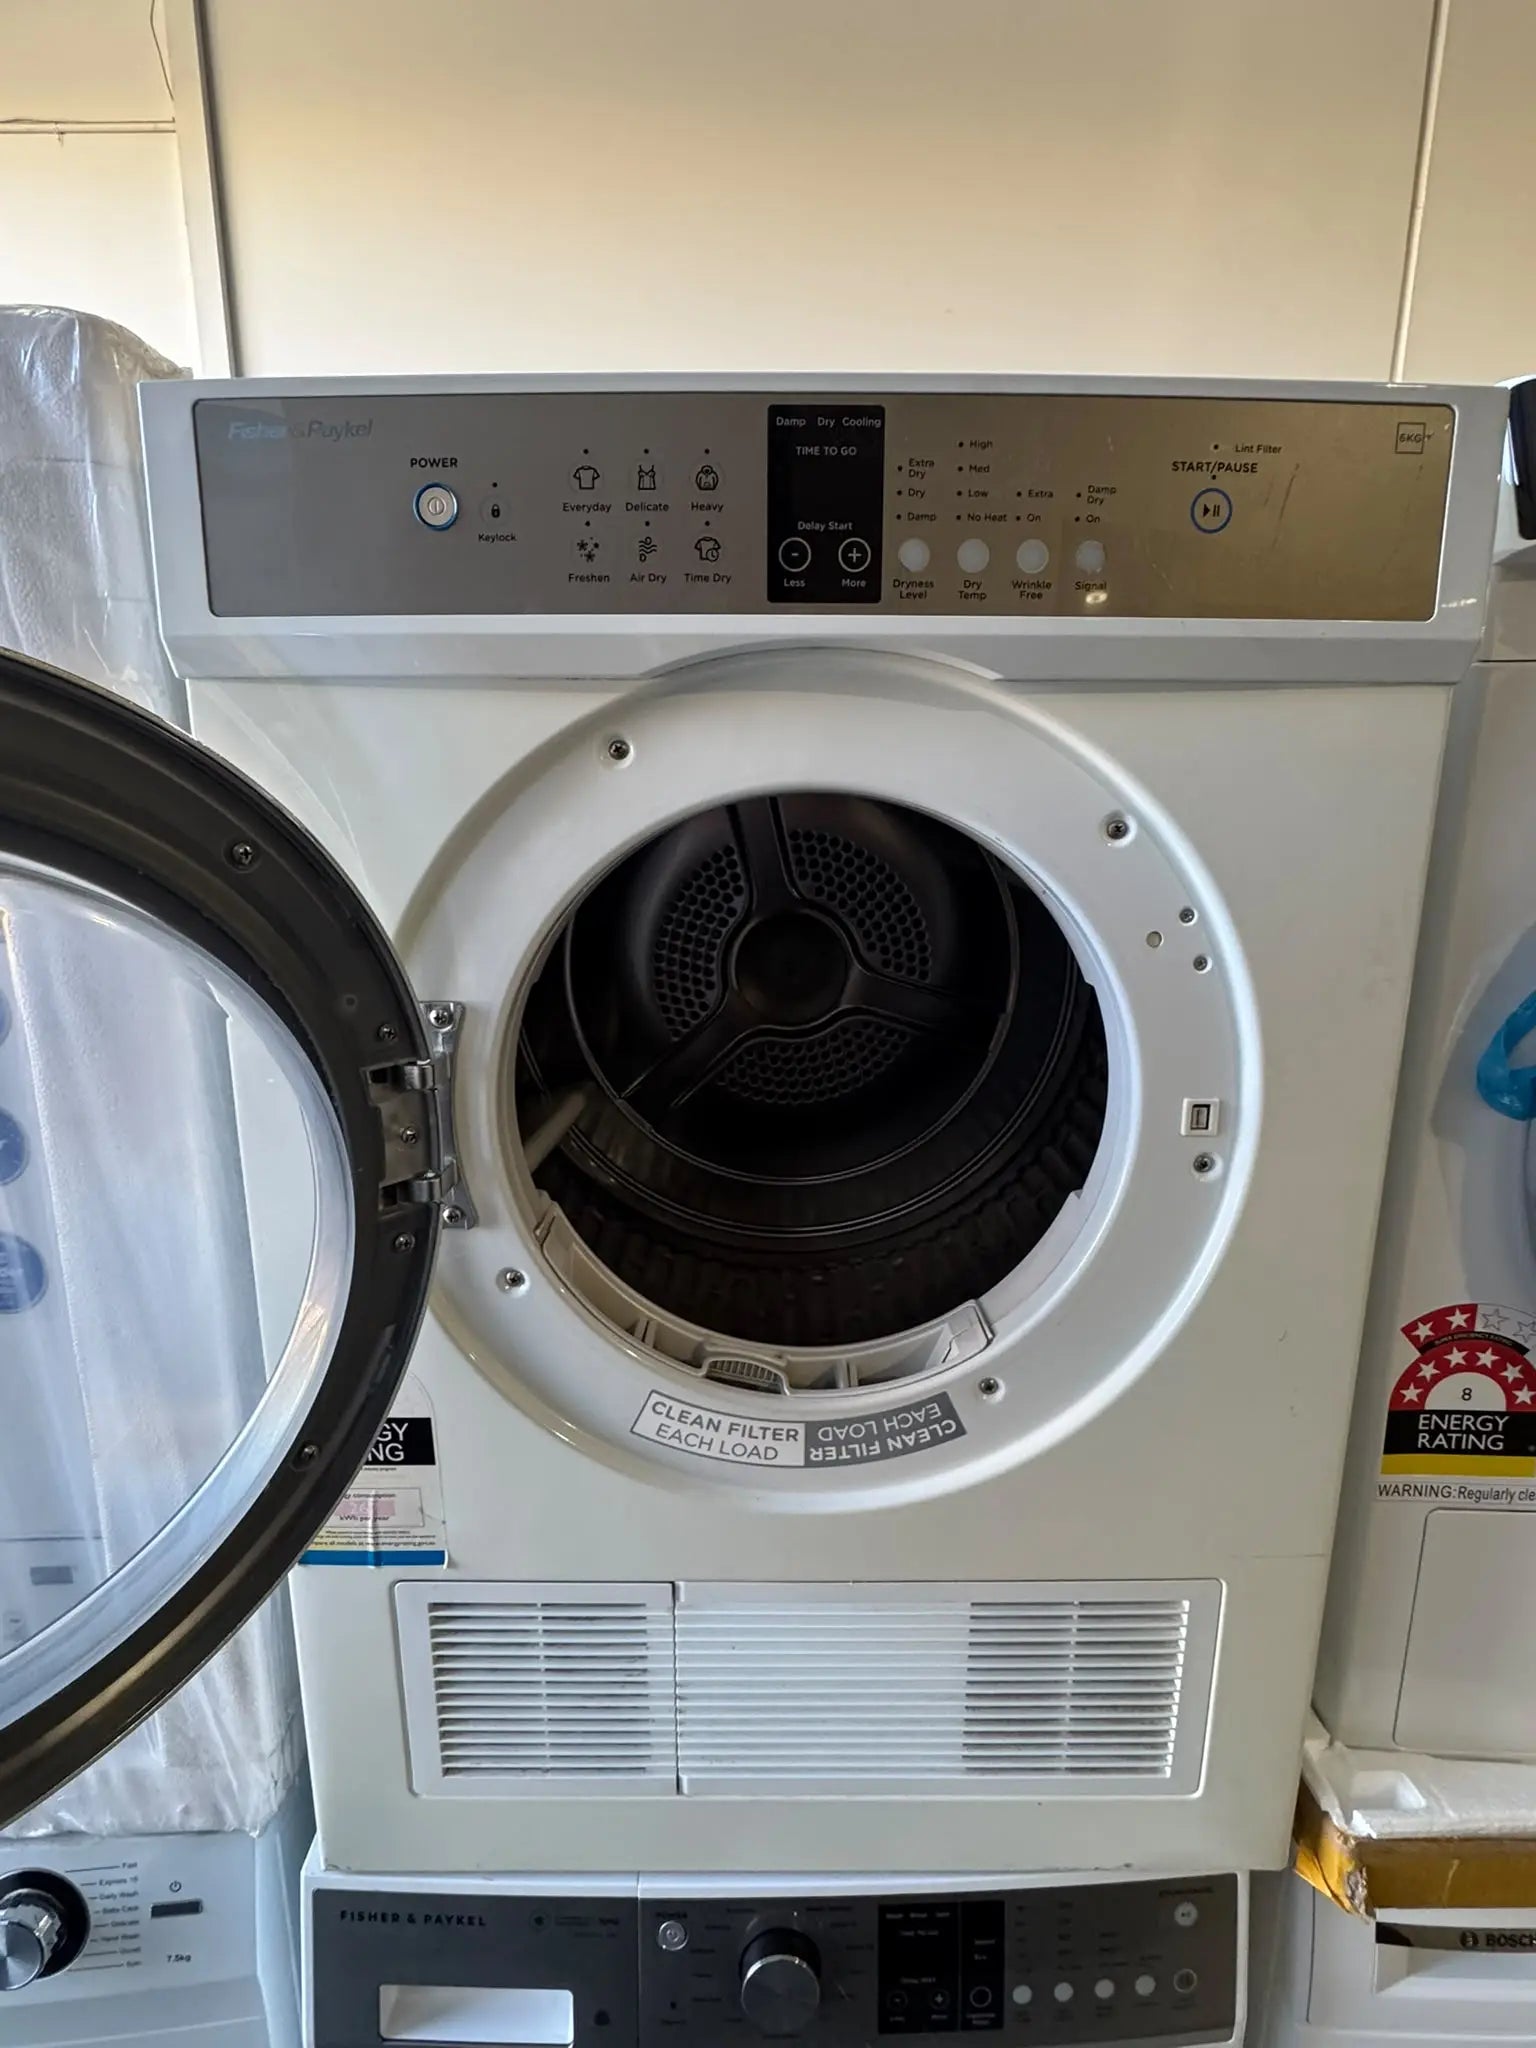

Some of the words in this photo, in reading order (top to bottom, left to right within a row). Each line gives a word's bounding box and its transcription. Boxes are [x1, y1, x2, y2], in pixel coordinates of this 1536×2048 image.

[776, 416, 806, 428] Damp
[817, 417, 836, 428] Dry
[842, 417, 882, 429] Cooling
[969, 439, 993, 450] High
[1235, 444, 1254, 454] Lint
[1257, 444, 1283, 455] Filter
[796, 446, 820, 456] TIME
[823, 446, 838, 456] TO
[841, 446, 857, 456] GO
[410, 458, 458, 468] POWER
[909, 458, 935, 468] Extra
[1172, 461, 1258, 473] START/PAUSE
[908, 468, 926, 480] Dry
[968, 464, 990, 474] Med
[908, 488, 926, 499] Dry
[968, 489, 989, 498] Low
[1028, 489, 1054, 499] Extra
[1087, 495, 1105, 506] Dry
[562, 502, 611, 514] Everyday
[625, 502, 669, 512] Delicate
[691, 502, 724, 513] Heavy
[907, 512, 937, 523] Damp
[967, 513, 982, 522] No
[984, 513, 1008, 522] Heat
[1027, 513, 1042, 522] On
[1086, 514, 1101, 524] On
[797, 521, 826, 532] Delay
[828, 521, 853, 531] Start
[478, 533, 517, 544] Keylock
[568, 573, 610, 583] Freshen
[630, 573, 646, 583] Air
[650, 573, 667, 584] Dry
[684, 573, 710, 583] Time
[713, 574, 732, 584] Dry
[784, 578, 806, 588] Less
[841, 578, 867, 588] More
[893, 579, 935, 592] Dryness
[963, 580, 983, 591] Dry
[1012, 580, 1052, 590] Wrinkle
[1075, 581, 1107, 592] Signal
[900, 590, 927, 600] Level
[958, 591, 987, 601] Temp
[1020, 590, 1043, 600] Free
[1461, 1387, 1472, 1401] 8
[651, 1401, 721, 1434] CLEAN
[728, 1423, 799, 1443] FILTER
[884, 1402, 943, 1433] EACH
[1418, 1414, 1510, 1432] ENERGY
[817, 1420, 878, 1442] LOAD
[887, 1419, 957, 1451] CLEAN
[655, 1424, 713, 1452] EACH
[719, 1440, 779, 1461] LOAD
[1417, 1432, 1505, 1451] RATING
[810, 1440, 881, 1462] FILTER
[340, 1909, 400, 1924] FISHER
[407, 1912, 417, 1924] &
[424, 1914, 487, 1927] PAYKEL
